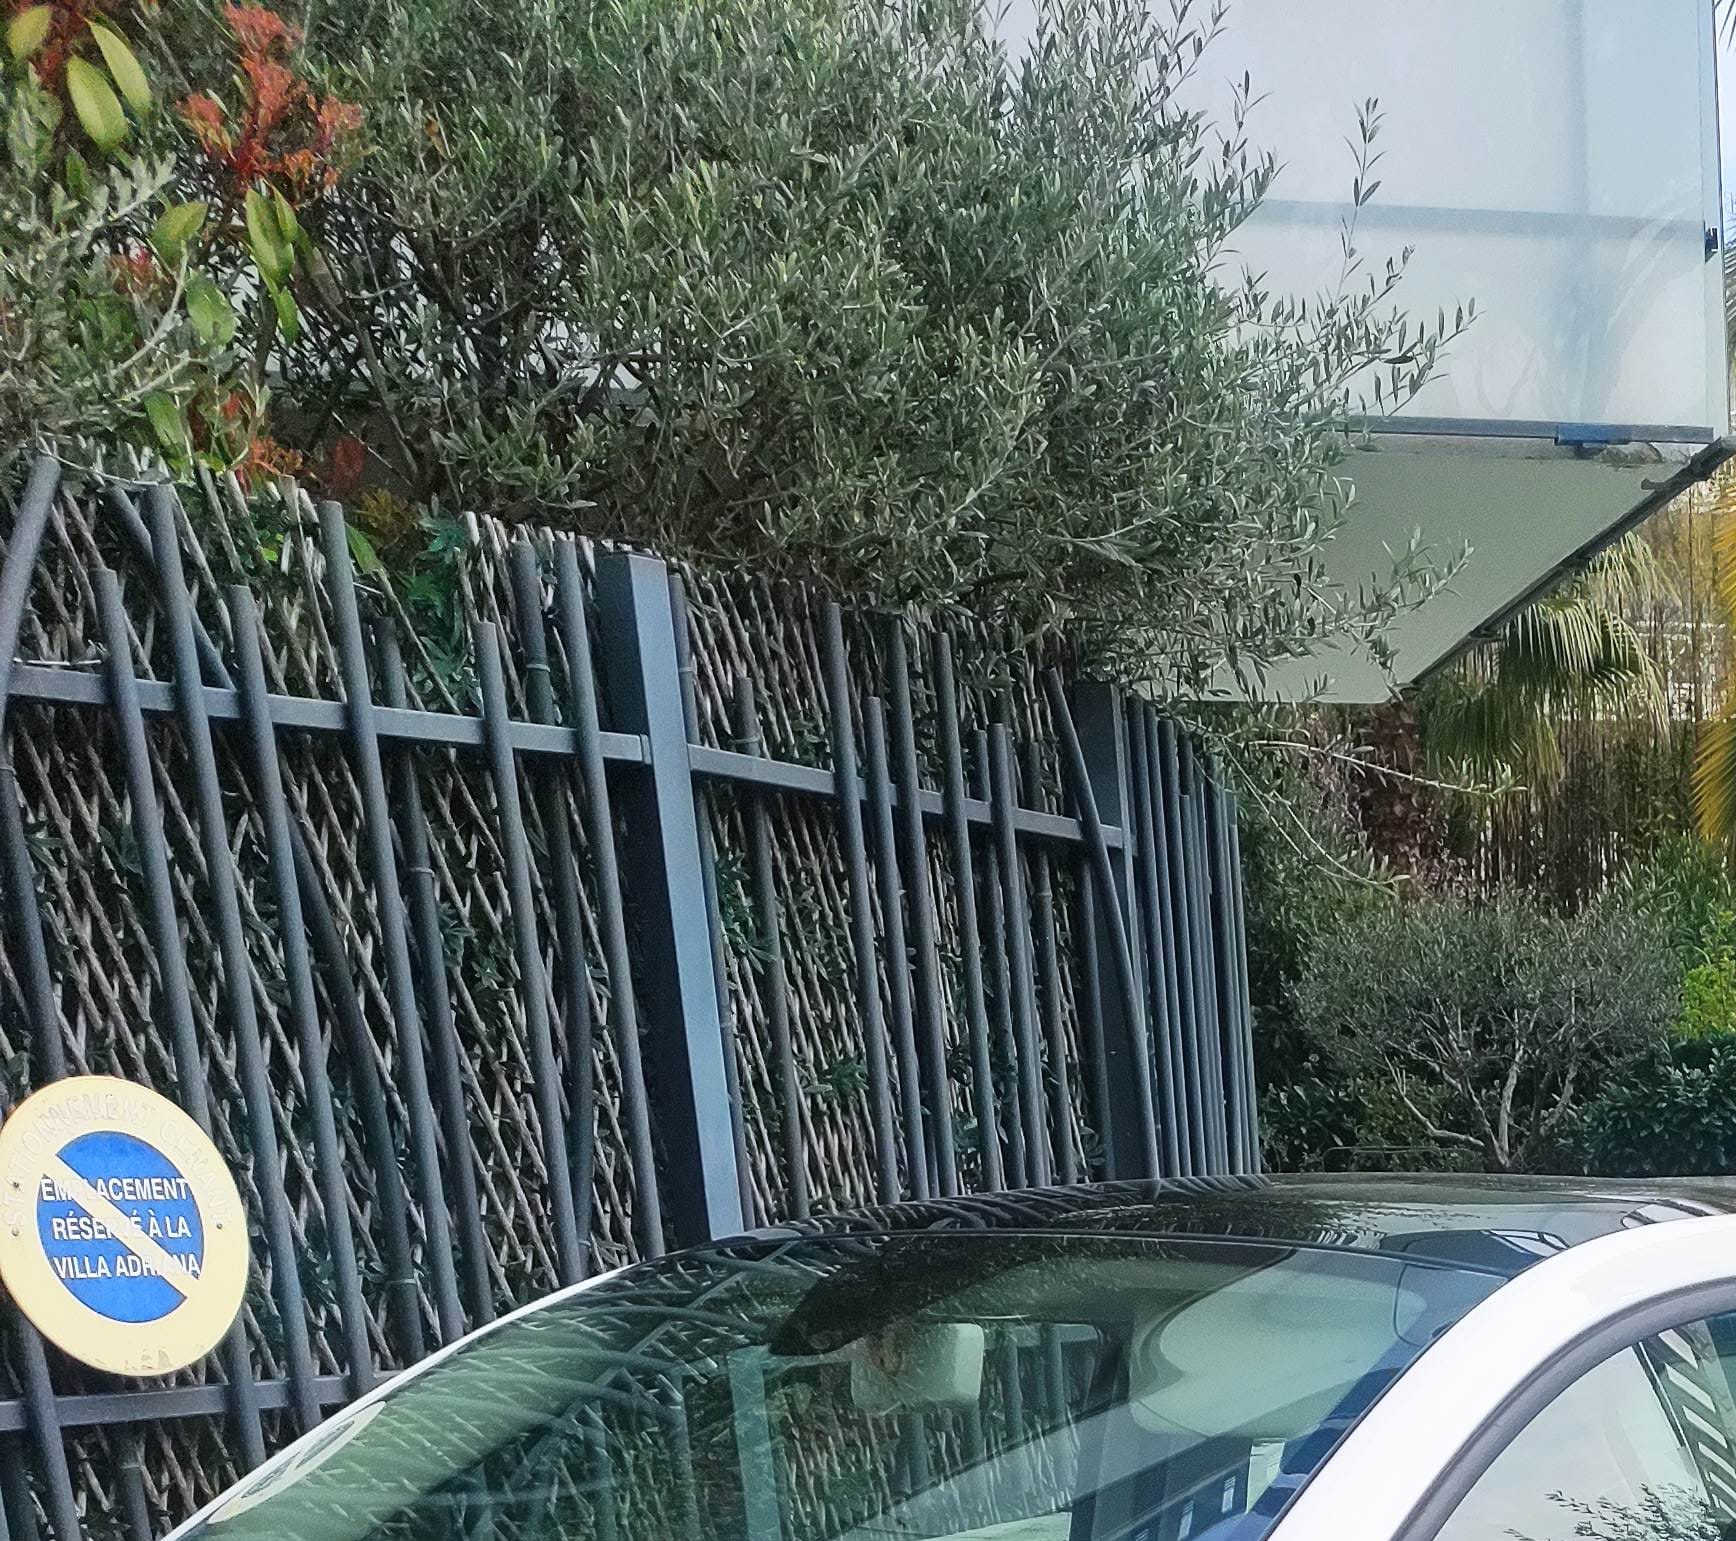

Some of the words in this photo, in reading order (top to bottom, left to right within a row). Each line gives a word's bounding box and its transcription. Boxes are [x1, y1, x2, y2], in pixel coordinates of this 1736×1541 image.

[41, 1177, 189, 1200] EMACEMENT
[52, 1210, 142, 1239] RÉSEÉ
[148, 1210, 163, 1238] À
[165, 1217, 192, 1238] LA
[53, 1256, 112, 1278] VILLA
[115, 1254, 200, 1277] ADRNA
